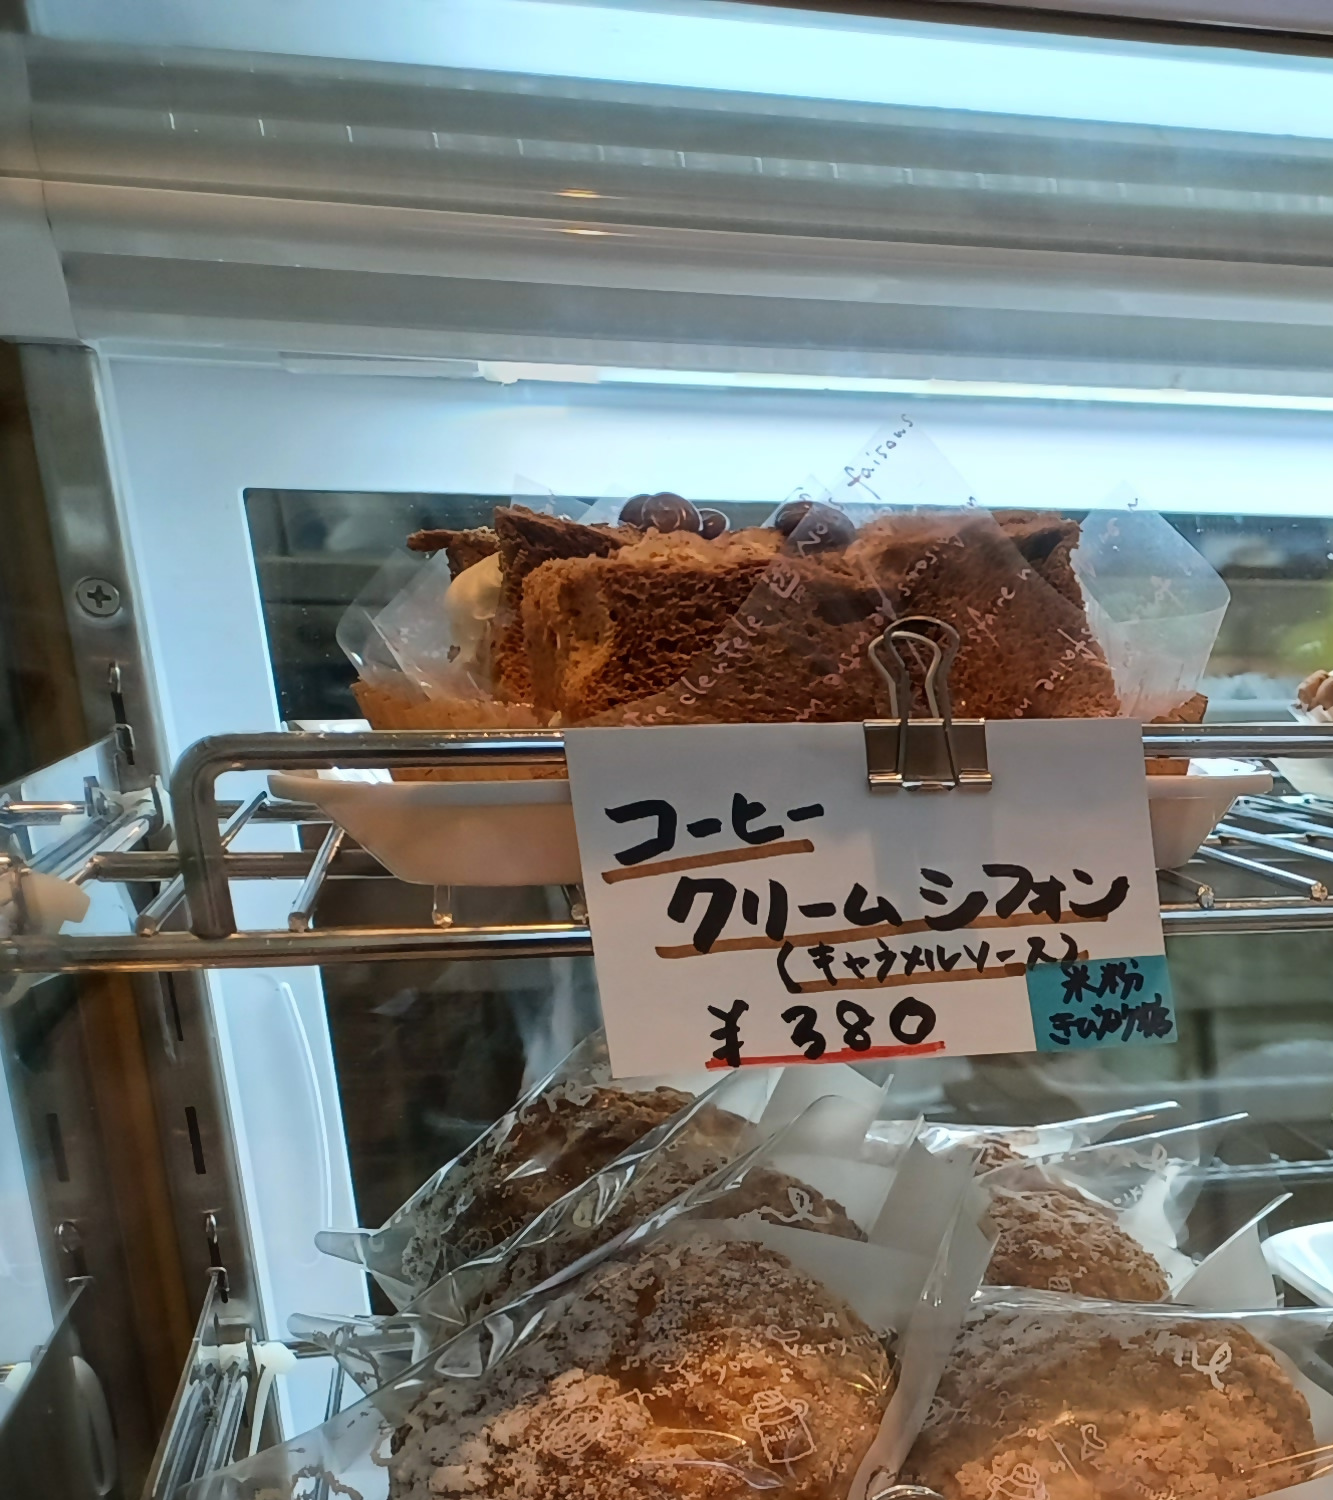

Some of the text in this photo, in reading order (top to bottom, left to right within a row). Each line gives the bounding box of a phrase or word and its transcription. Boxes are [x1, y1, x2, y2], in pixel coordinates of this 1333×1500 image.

[605, 793, 824, 864] コーヒー
[667, 864, 1128, 953] クリームシフォン
[1059, 959, 1145, 1003] 米粉
[707, 998, 937, 1067] ¥380
